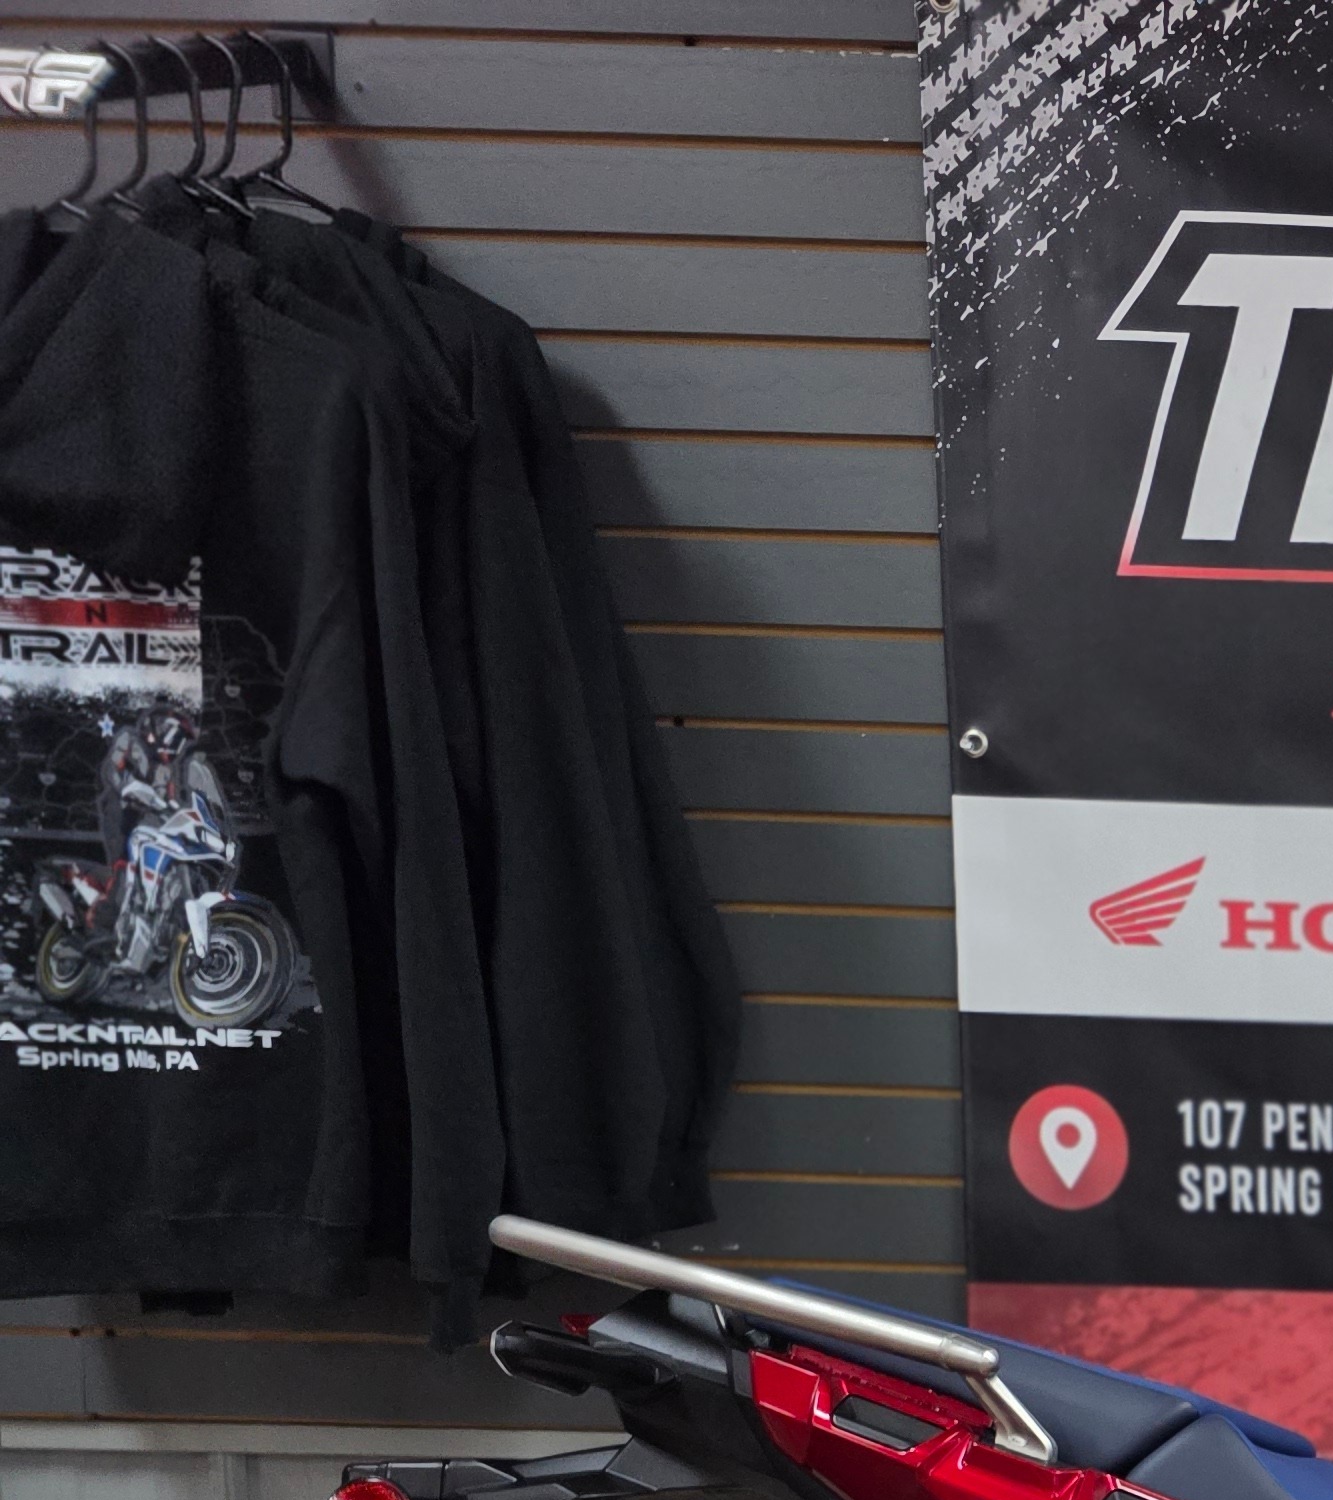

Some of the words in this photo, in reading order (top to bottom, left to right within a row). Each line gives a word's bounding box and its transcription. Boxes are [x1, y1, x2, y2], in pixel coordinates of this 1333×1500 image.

[86, 603, 108, 624] N
[16, 1045, 119, 1072] Spring
[166, 1050, 199, 1071] PA
[1177, 1100, 1243, 1149] 107
[1178, 1164, 1322, 1216] SPRING
